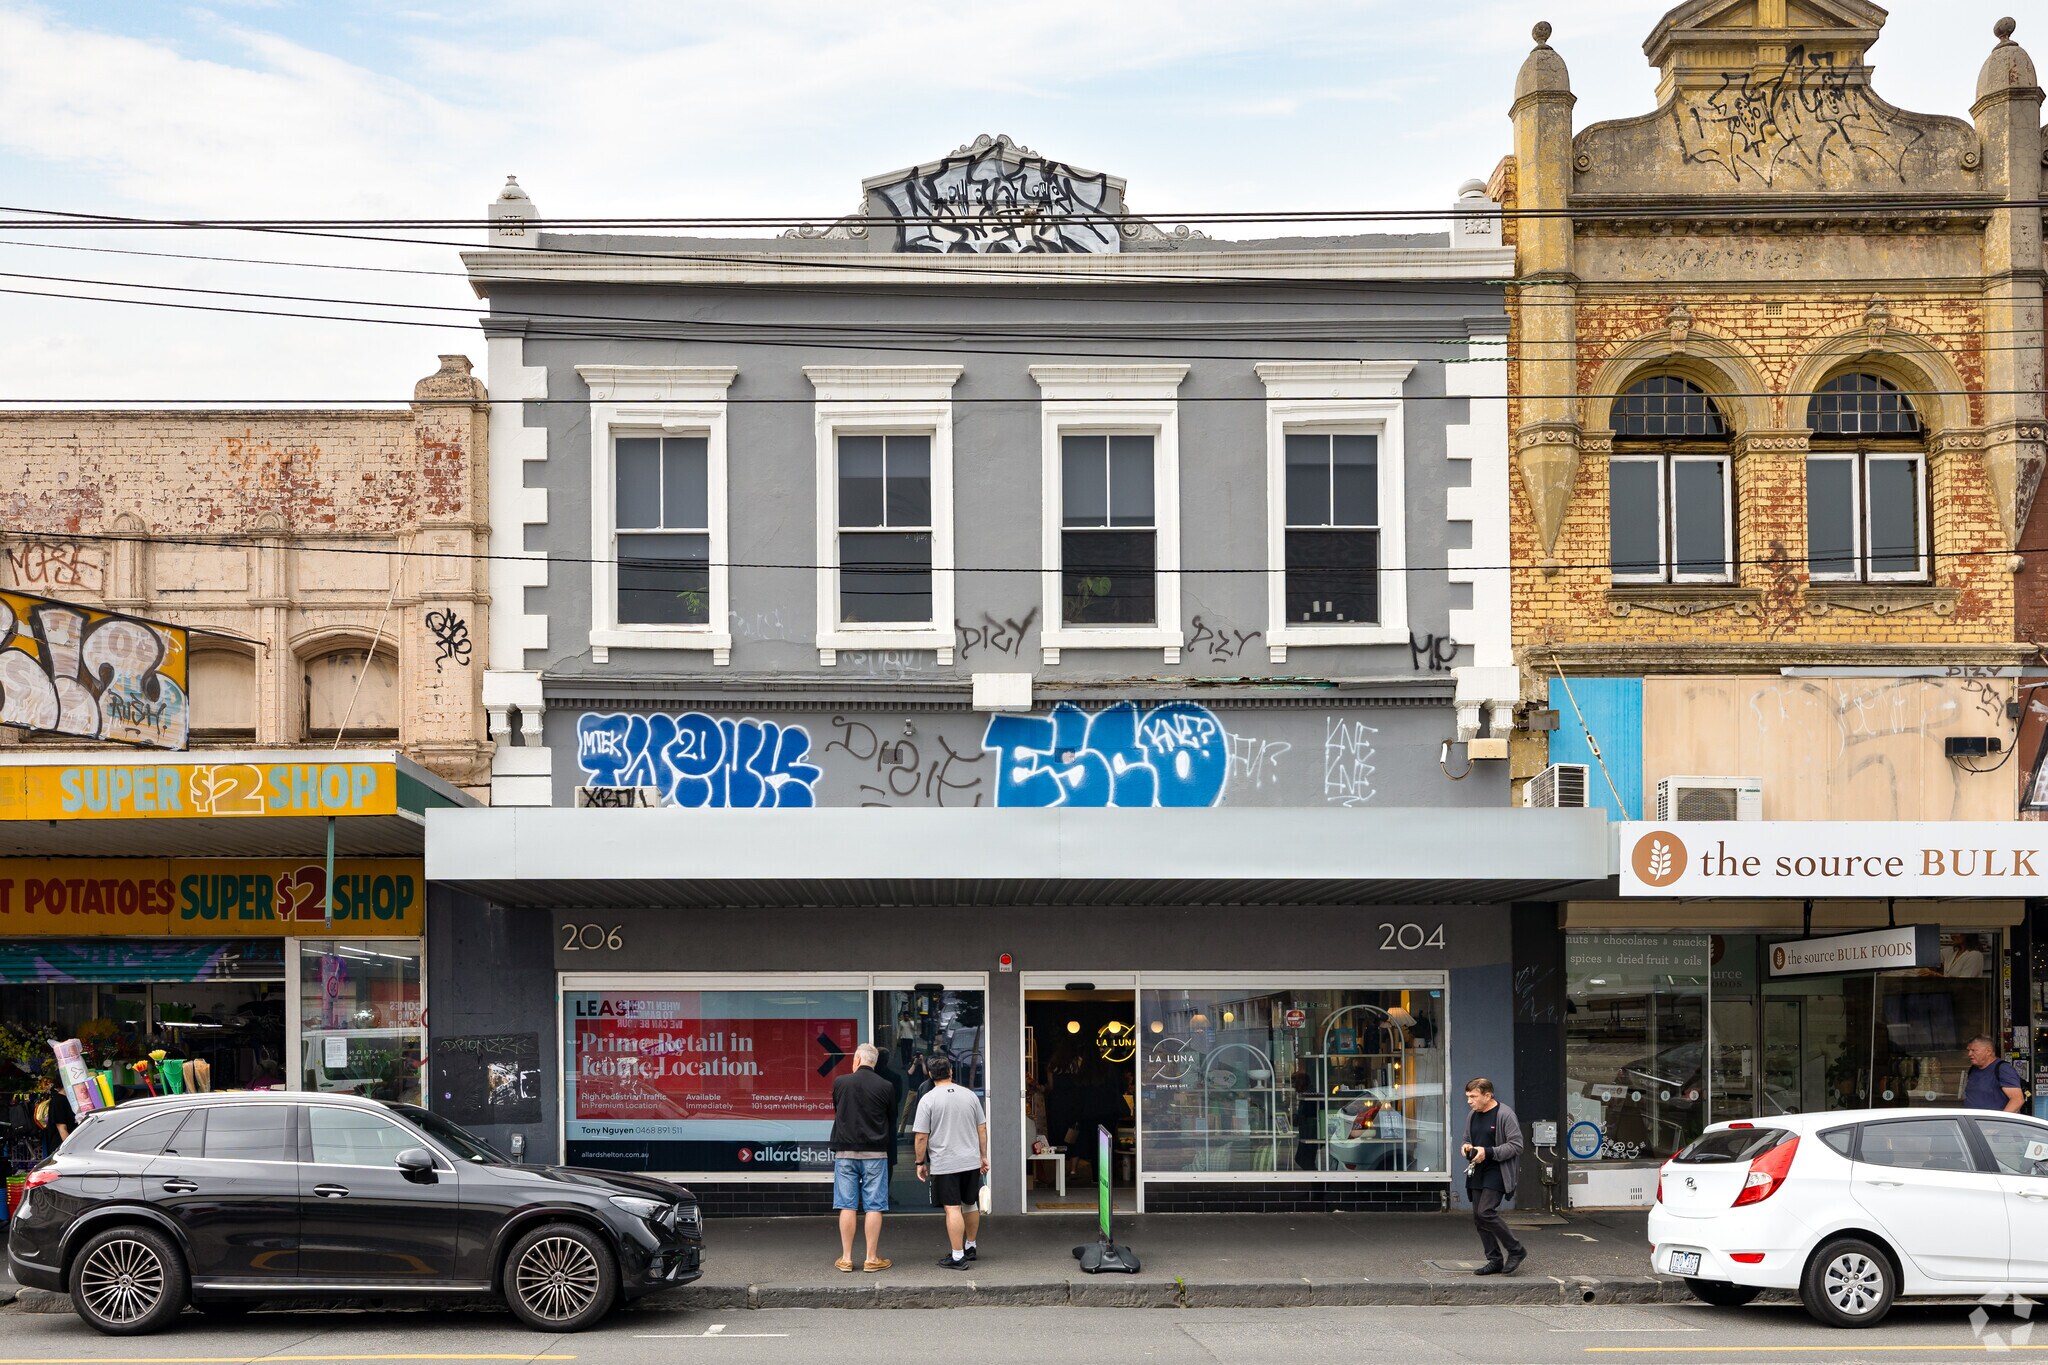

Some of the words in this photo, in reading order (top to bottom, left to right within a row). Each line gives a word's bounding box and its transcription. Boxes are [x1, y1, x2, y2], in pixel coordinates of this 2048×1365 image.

[60, 766, 183, 812] SUPER
[189, 764, 265, 815] $2
[268, 765, 378, 811] SHOP
[1700, 840, 1761, 877] the
[1775, 854, 1904, 877] source
[1919, 848, 2040, 877] BULK
[24, 878, 176, 915] POTATOES
[180, 874, 275, 921] SUPER
[275, 865, 327, 922] $2
[332, 874, 415, 920] SHOP
[561, 923, 624, 951] 206
[1378, 923, 1446, 950] 204
[1566, 935, 1589, 944] nuts
[1603, 935, 1658, 946] chocolates
[1672, 936, 1707, 947] snacks
[1787, 950, 1802, 965] the
[1803, 951, 1835, 963] source
[1837, 946, 1868, 961] BULK
[1871, 942, 1912, 959] FOODS
[1570, 955, 1602, 966] spices
[1616, 954, 1643, 964] dried
[1646, 954, 1669, 965] fruit
[1683, 955, 1702, 965] oils
[581, 1032, 650, 1053] Prime
[658, 1032, 723, 1053] Retail
[731, 1032, 753, 1053] in
[1096, 1039, 1107, 1047] LA
[1148, 1055, 1162, 1063] LA
[1167, 1055, 1194, 1063] LUNA
[658, 1056, 764, 1076] Location.
[601, 1093, 641, 1101] Pedestrian
[642, 1093, 667, 1101] Traffic
[686, 1093, 721, 1101] Available
[751, 1093, 783, 1103] Tenancy
[784, 1093, 805, 1101] Area:
[686, 1102, 734, 1111] Immediately
[763, 1103, 779, 1111] sqm
[799, 1102, 818, 1111] High
[581, 1126, 600, 1135] Tony
[602, 1126, 634, 1135] Nguyen
